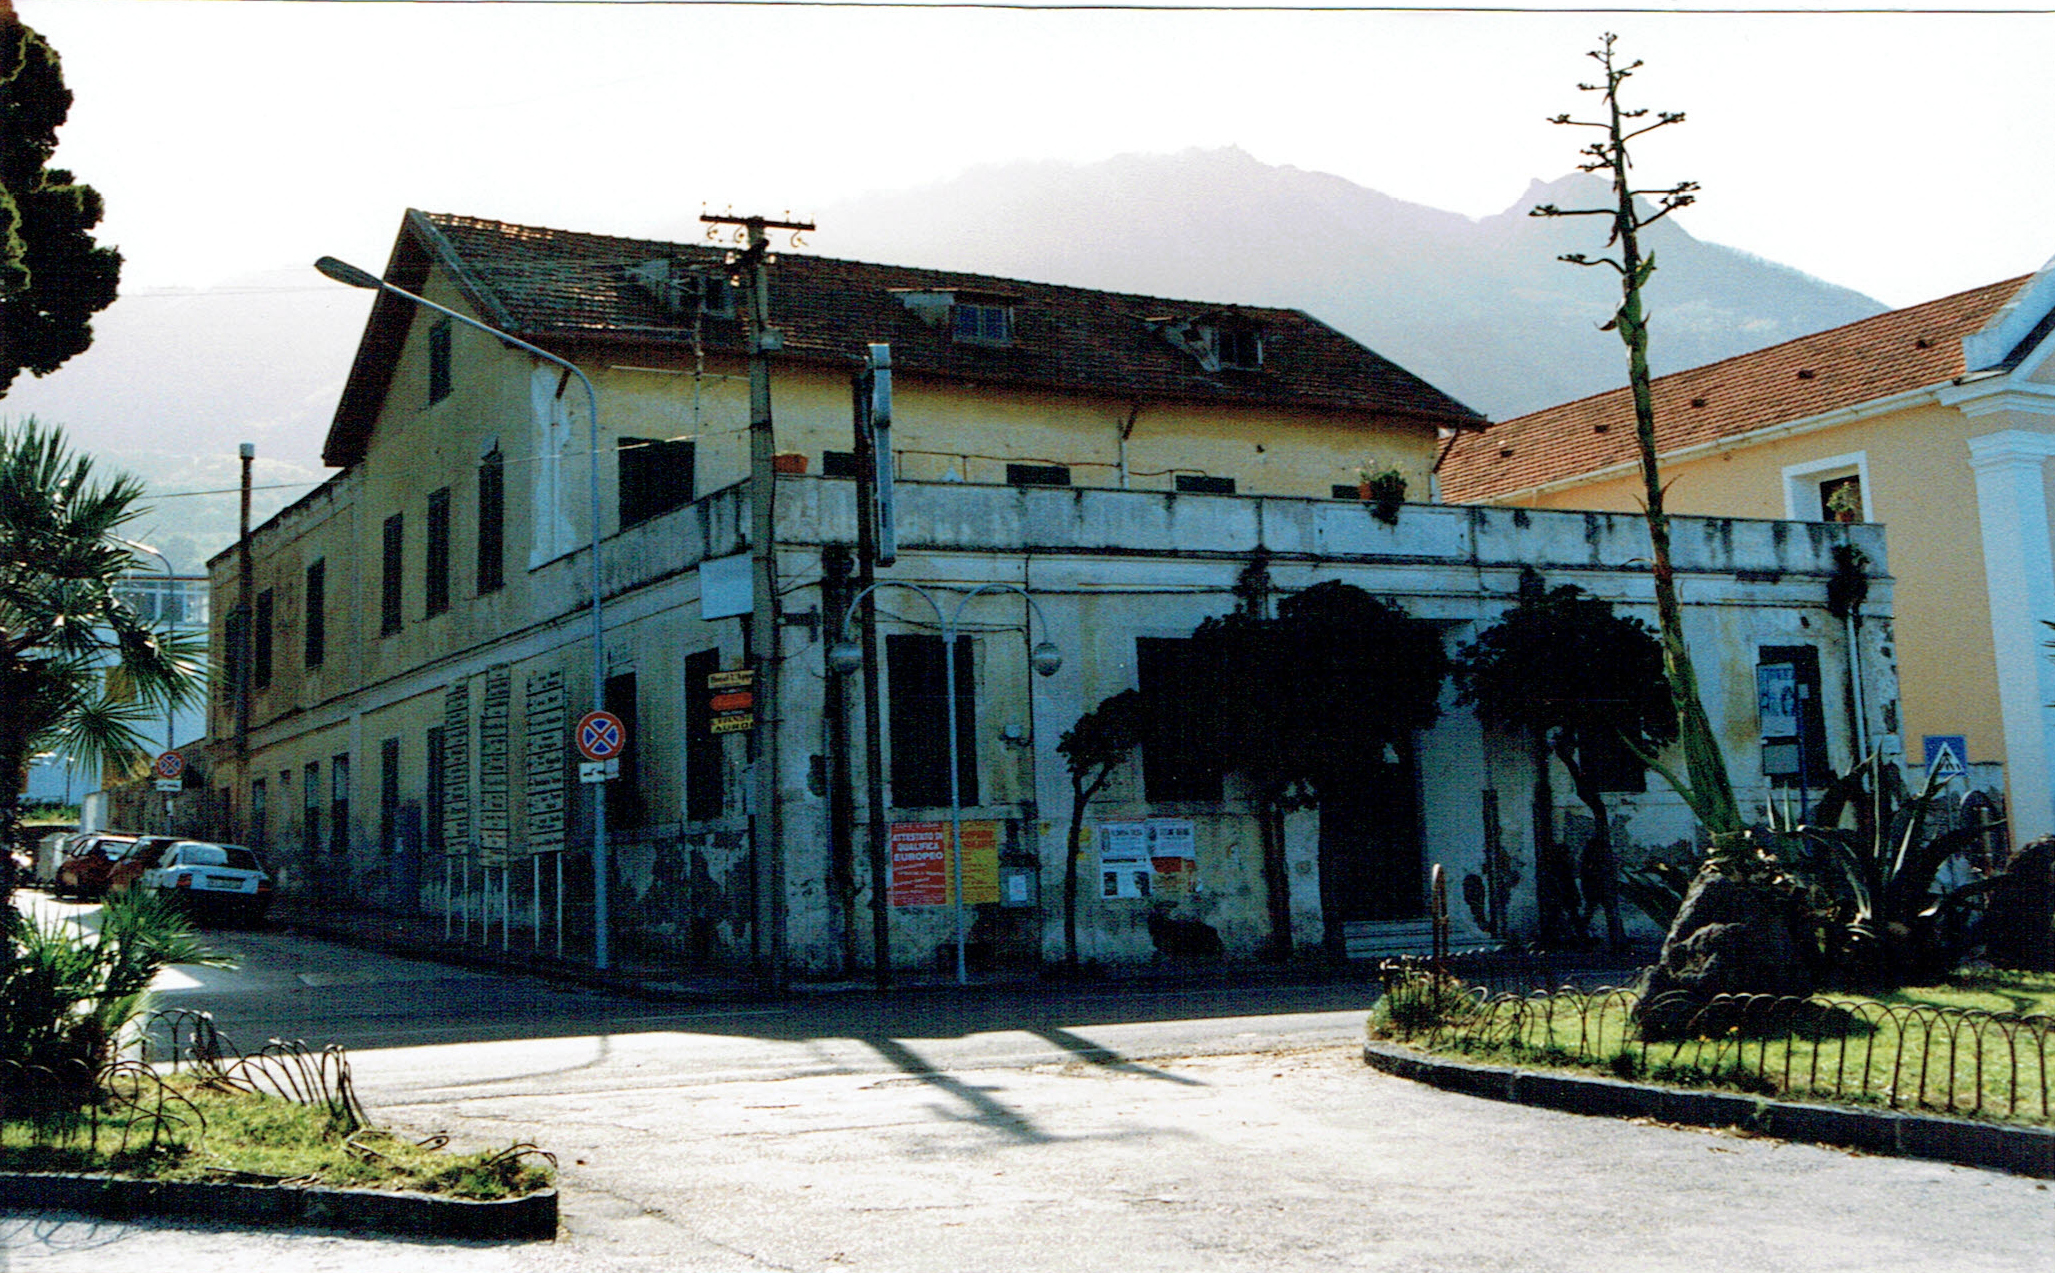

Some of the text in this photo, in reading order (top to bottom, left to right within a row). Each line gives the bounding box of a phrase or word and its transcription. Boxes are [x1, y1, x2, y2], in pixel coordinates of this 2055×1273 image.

[892, 832, 943, 841] ATTESTATO DI
[897, 842, 939, 852] QUALIFICA
[894, 851, 943, 862] EUROPEO
